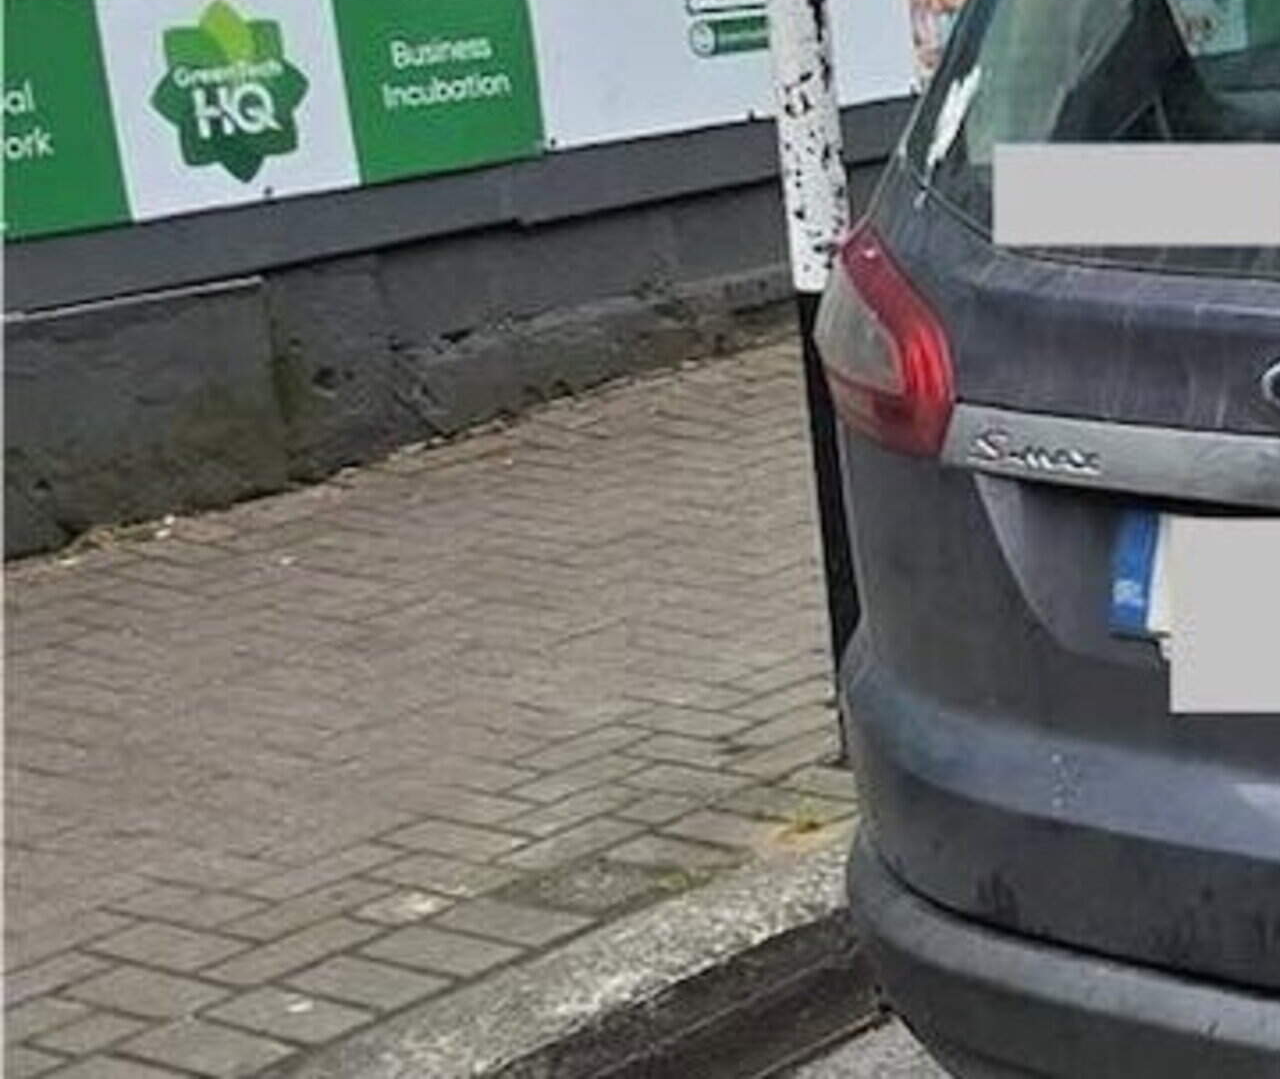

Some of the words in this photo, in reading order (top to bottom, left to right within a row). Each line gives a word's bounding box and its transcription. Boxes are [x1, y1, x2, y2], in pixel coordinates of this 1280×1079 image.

[389, 34, 494, 70] Business
[173, 58, 284, 89] GreenTech
[382, 70, 512, 110] Incubation
[192, 82, 283, 139] HQ
